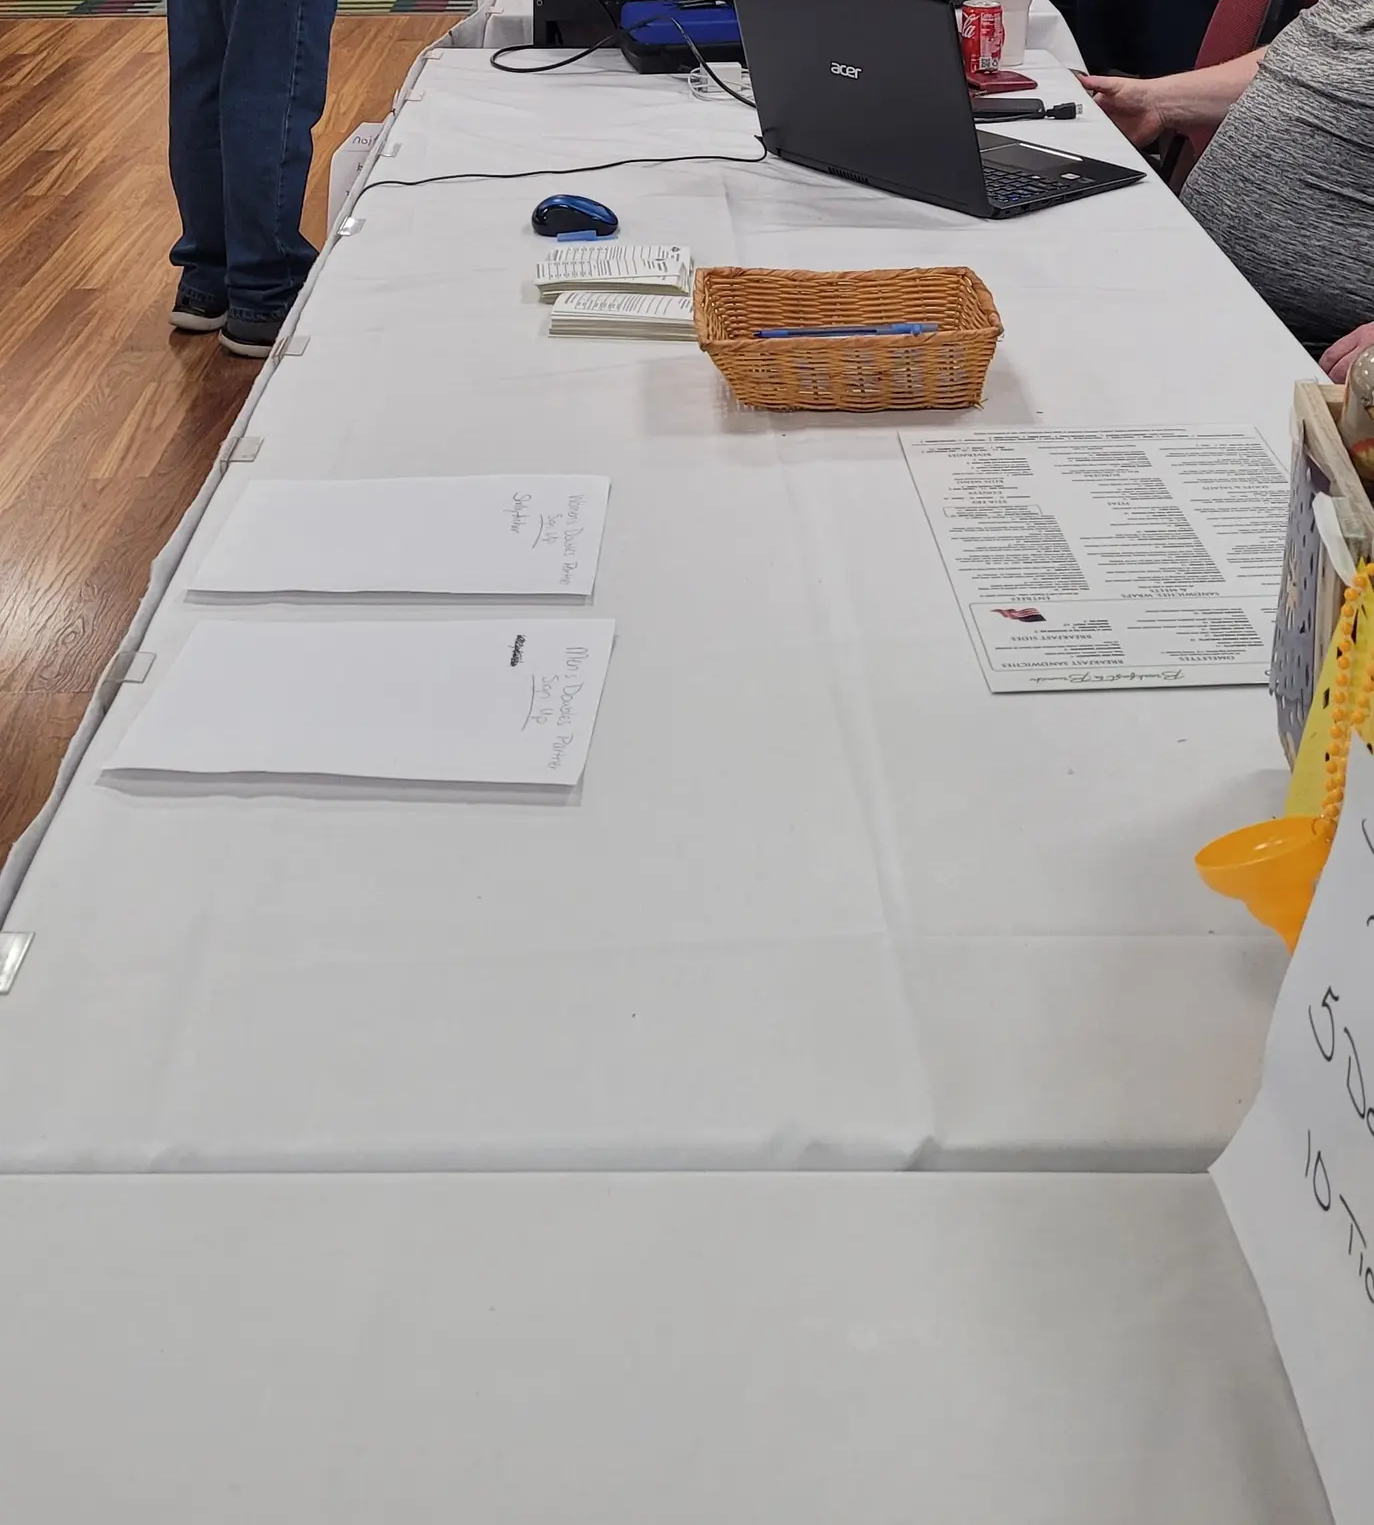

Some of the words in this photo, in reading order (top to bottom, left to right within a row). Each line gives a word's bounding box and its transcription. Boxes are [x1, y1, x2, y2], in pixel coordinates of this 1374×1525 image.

[830, 61, 862, 79] acer
[1010, 635, 1038, 643] SIDES
[1041, 633, 1092, 641] BREAKFAST
[1001, 661, 1068, 669] SANDWICHES
[1071, 659, 1124, 667] BREAKFAST
[557, 681, 584, 726] Doubles
[1308, 986, 1340, 1062] 5
[1304, 1129, 1332, 1212] 10
